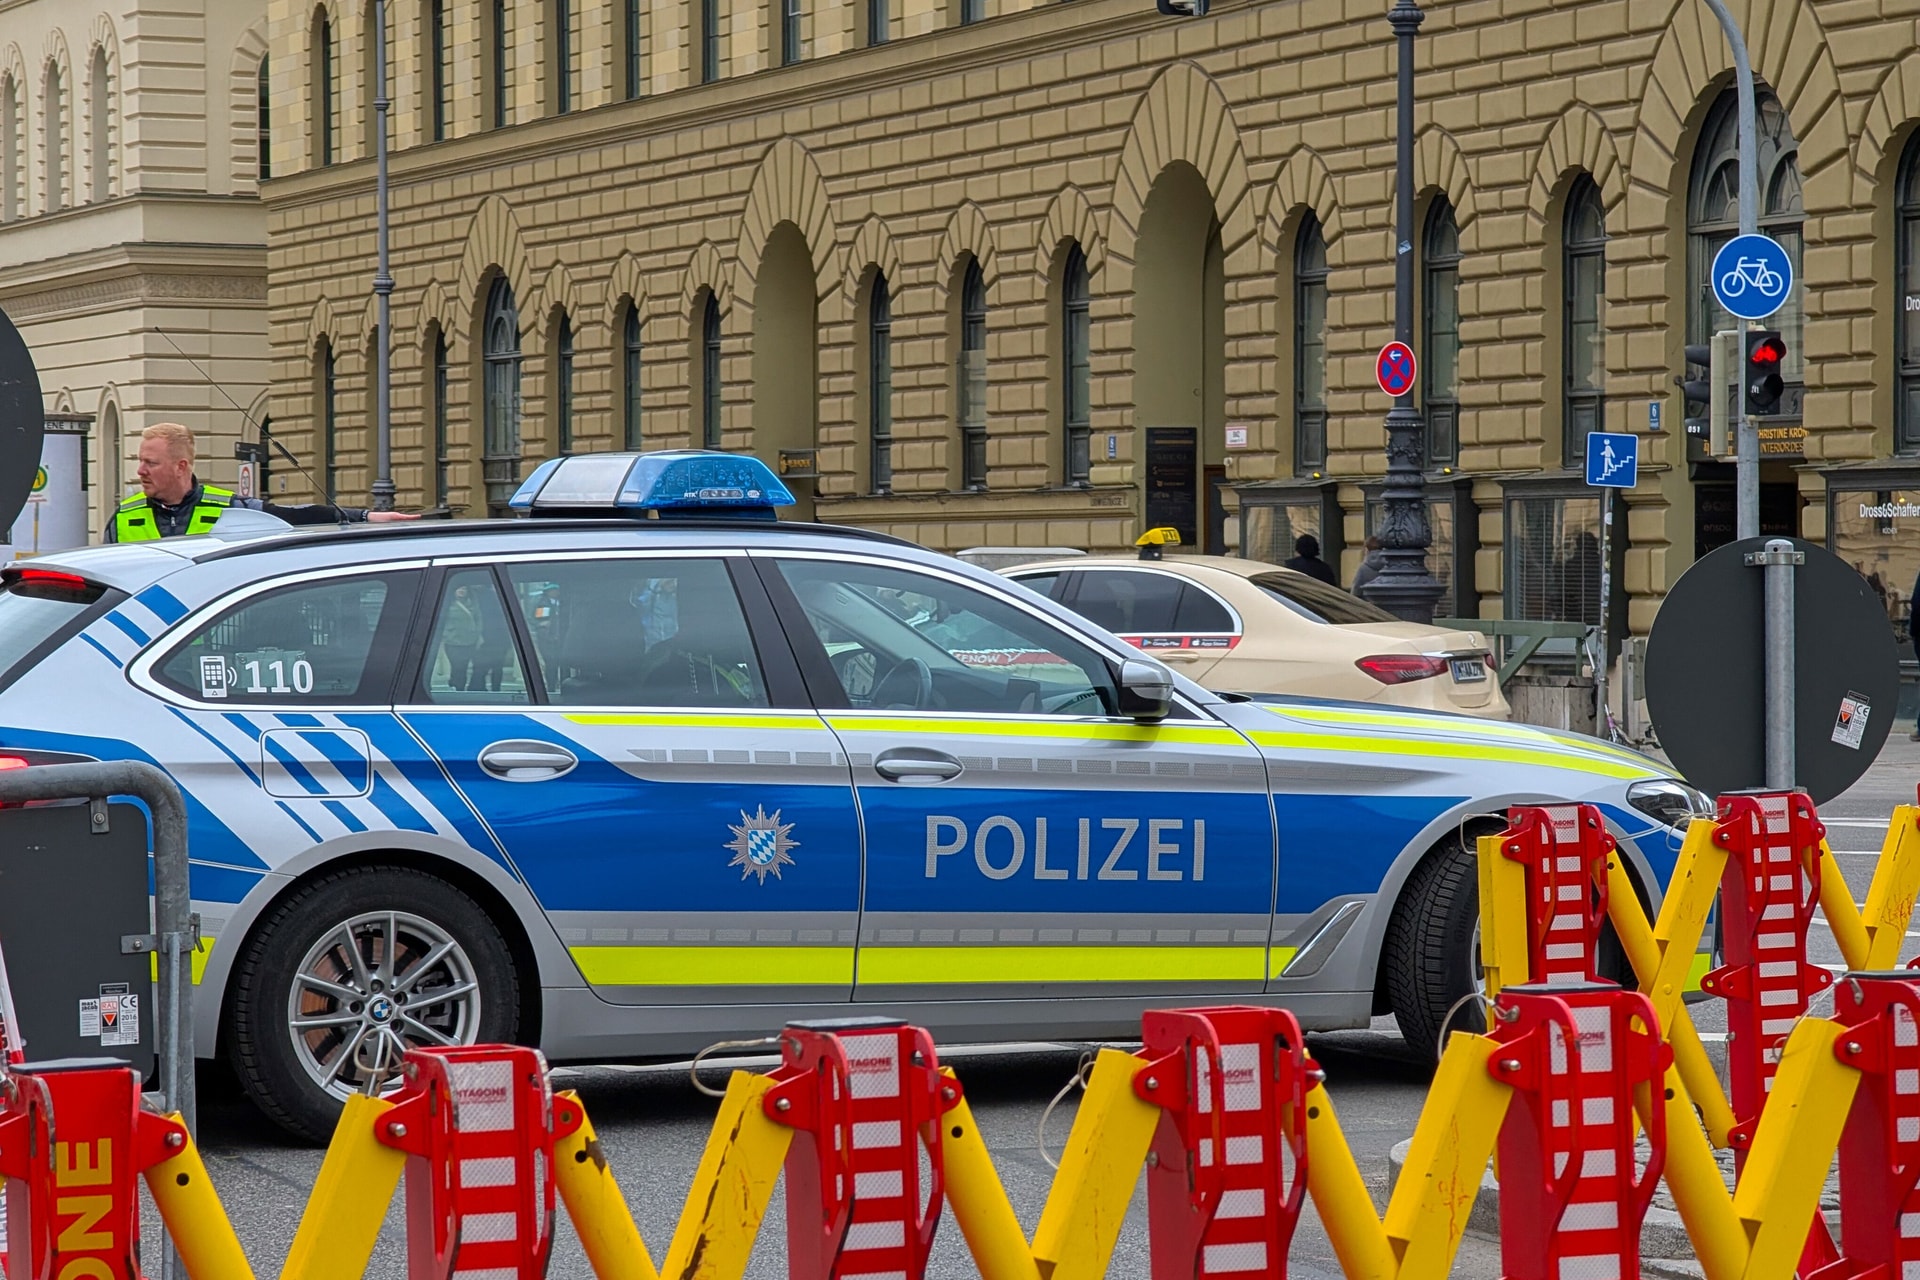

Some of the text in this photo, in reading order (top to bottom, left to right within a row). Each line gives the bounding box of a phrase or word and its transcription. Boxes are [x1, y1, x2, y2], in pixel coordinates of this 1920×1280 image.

[1652, 405, 1657, 417] 6
[245, 660, 314, 693] 110
[925, 815, 1205, 881] POLIZEI
[121, 1013, 137, 1021] 2016
